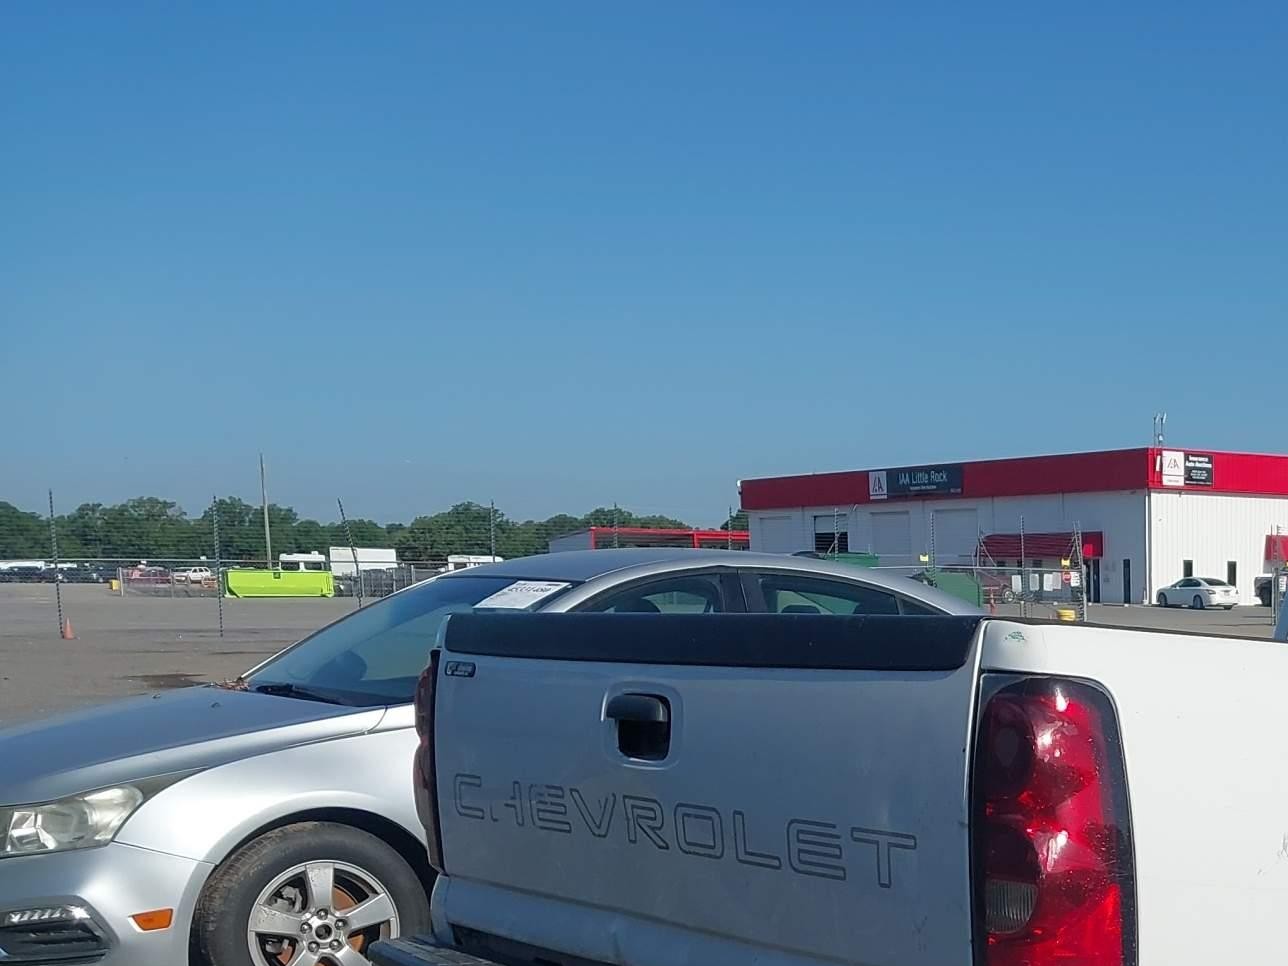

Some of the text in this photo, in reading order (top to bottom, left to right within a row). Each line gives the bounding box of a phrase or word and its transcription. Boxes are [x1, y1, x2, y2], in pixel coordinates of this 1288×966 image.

[911, 470, 929, 484] Little
[930, 470, 948, 482] Rock
[453, 773, 917, 889] CHEVROLET
